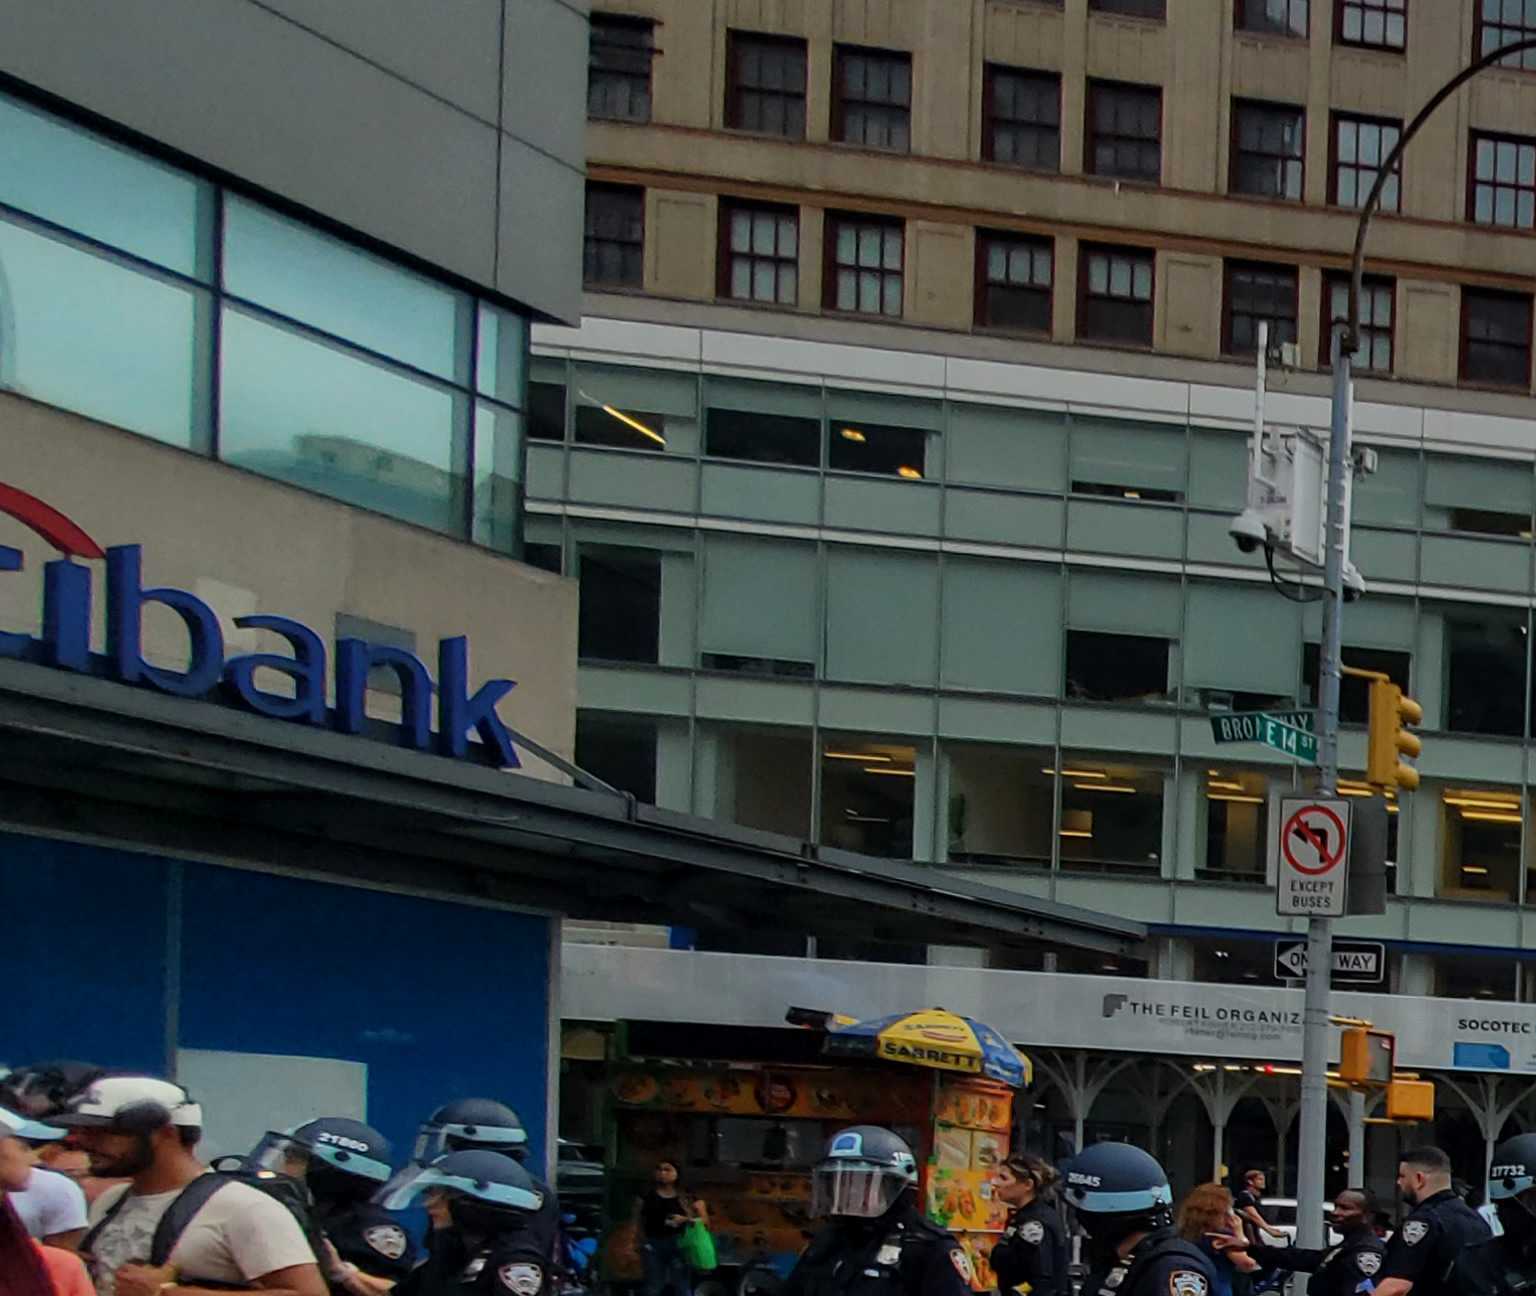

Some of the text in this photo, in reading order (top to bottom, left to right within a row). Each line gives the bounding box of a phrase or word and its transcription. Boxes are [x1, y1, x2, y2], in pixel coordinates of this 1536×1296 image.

[1220, 712, 1309, 741] BROAY
[1266, 721, 1276, 746] E
[1282, 727, 1297, 753] 14
[1290, 880, 1335, 893] EXCEPT
[1292, 895, 1331, 908] BUSES
[1290, 951, 1374, 969] ON WAY
[1130, 1002, 1305, 1025] THE FEIL ORGANIZ
[1458, 1018, 1531, 1034] SOCOTEC
